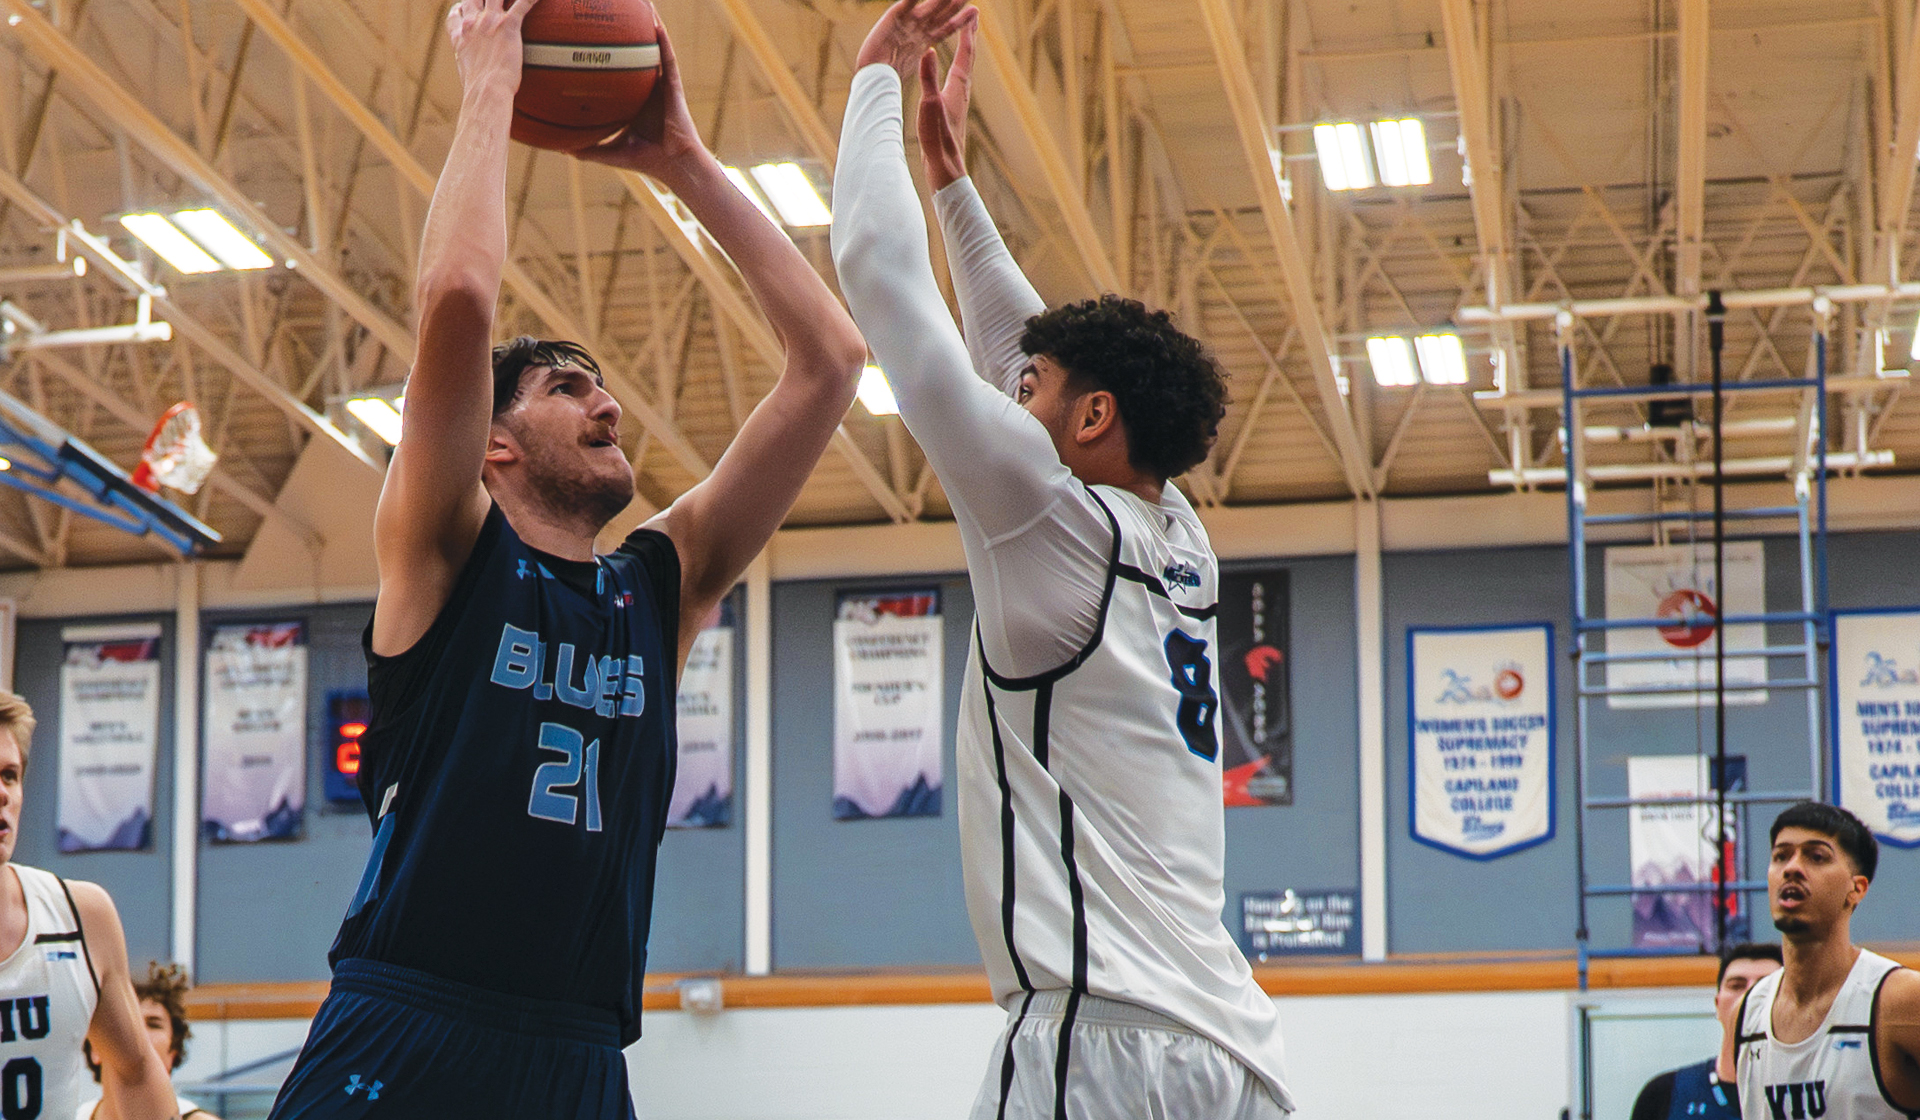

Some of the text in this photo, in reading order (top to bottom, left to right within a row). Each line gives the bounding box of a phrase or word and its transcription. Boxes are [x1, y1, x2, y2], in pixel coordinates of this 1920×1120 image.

[490, 622, 645, 719] BLUES
[1163, 627, 1219, 763] 8
[1438, 734, 1528, 751] SUPREMACY
[528, 722, 602, 832] 21
[1244, 897, 1305, 917] Hangg
[1269, 931, 1346, 948] Prohted
[1764, 1079, 1827, 1120] VIU
